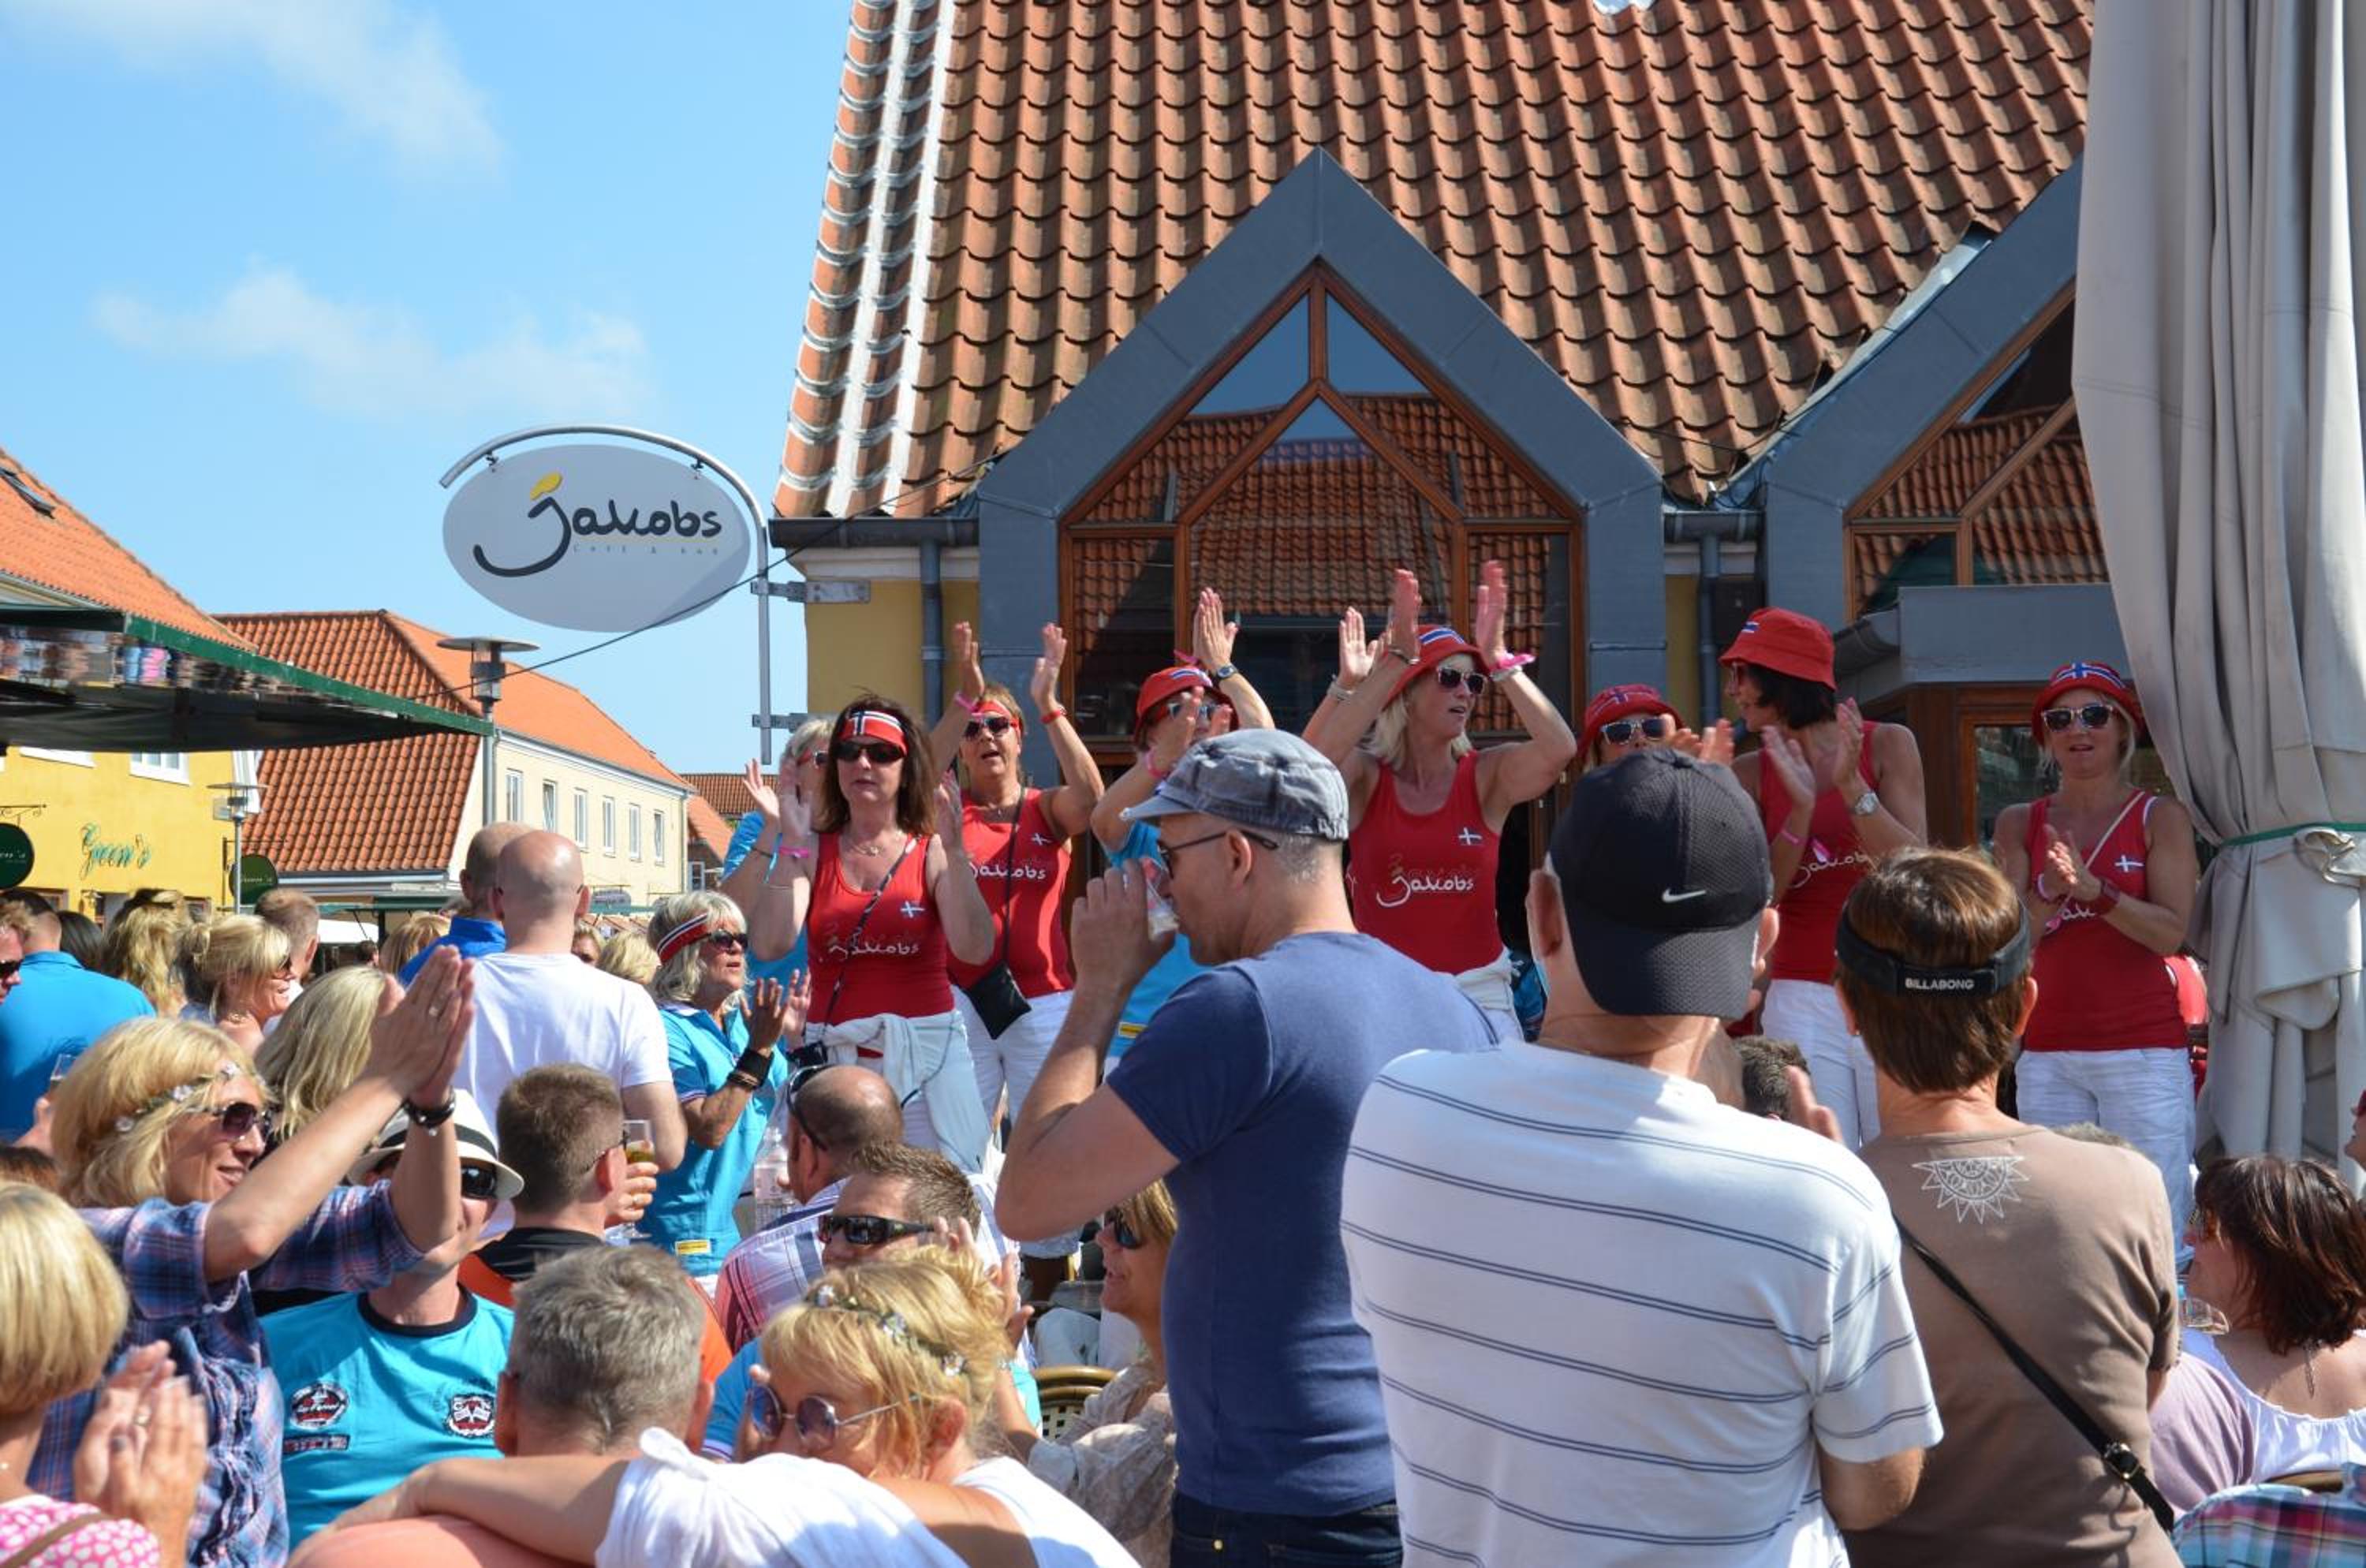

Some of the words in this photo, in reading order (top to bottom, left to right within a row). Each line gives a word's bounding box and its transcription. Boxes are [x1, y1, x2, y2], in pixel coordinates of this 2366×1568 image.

[473, 471, 722, 577] Jakobs
[1376, 870, 1474, 907] Jakobs
[1905, 977, 1975, 990] BILLABONG
